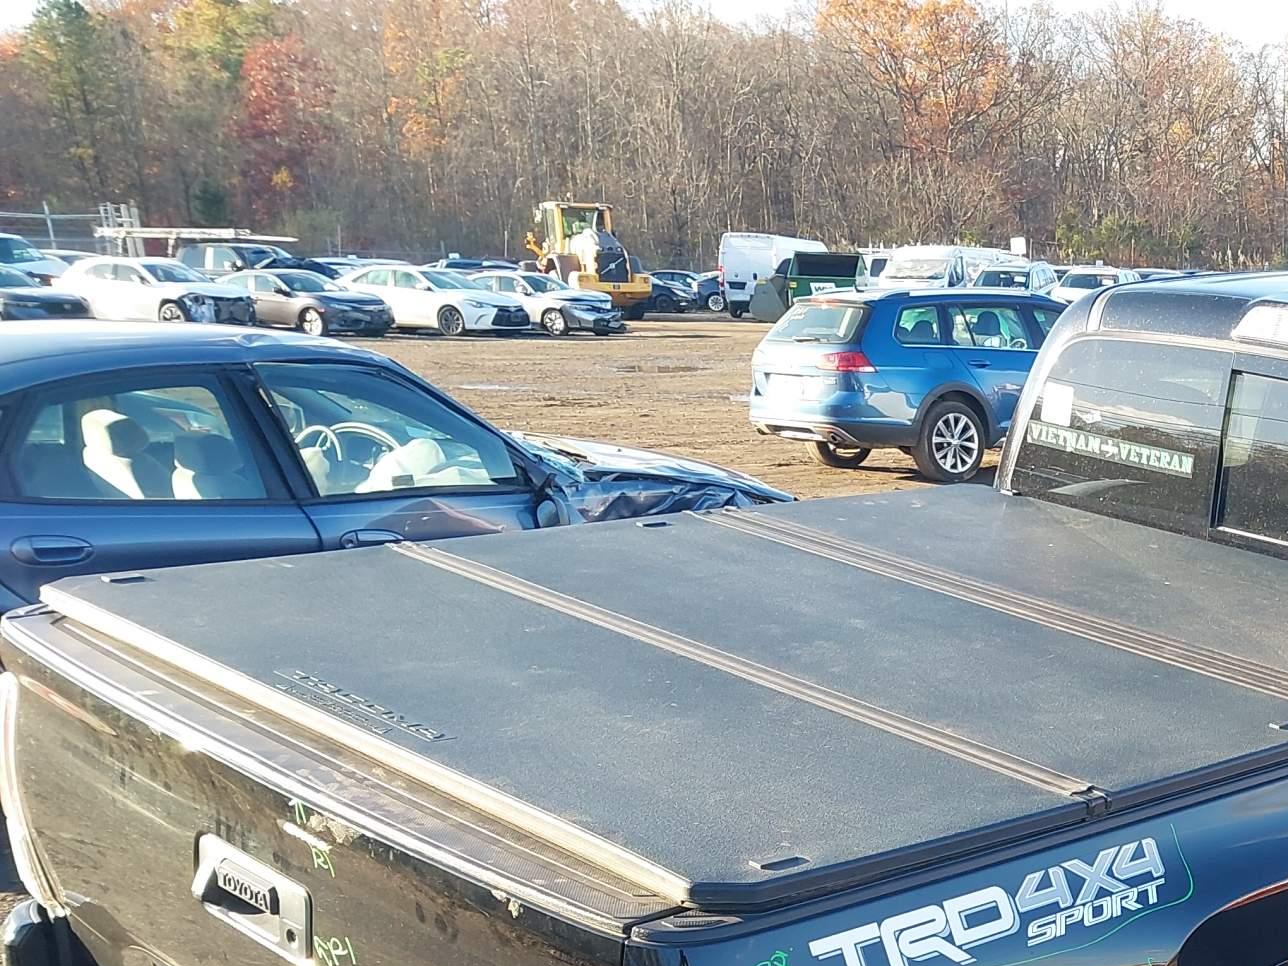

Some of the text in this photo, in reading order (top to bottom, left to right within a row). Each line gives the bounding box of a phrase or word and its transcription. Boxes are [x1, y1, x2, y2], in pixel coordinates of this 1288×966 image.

[1030, 423, 1194, 474] VIETNAM VETERAN
[292, 670, 445, 740] TACOMA
[222, 871, 269, 911] TOYOTA
[1017, 837, 1166, 914] 4X4
[1027, 878, 1166, 948] SPORT
